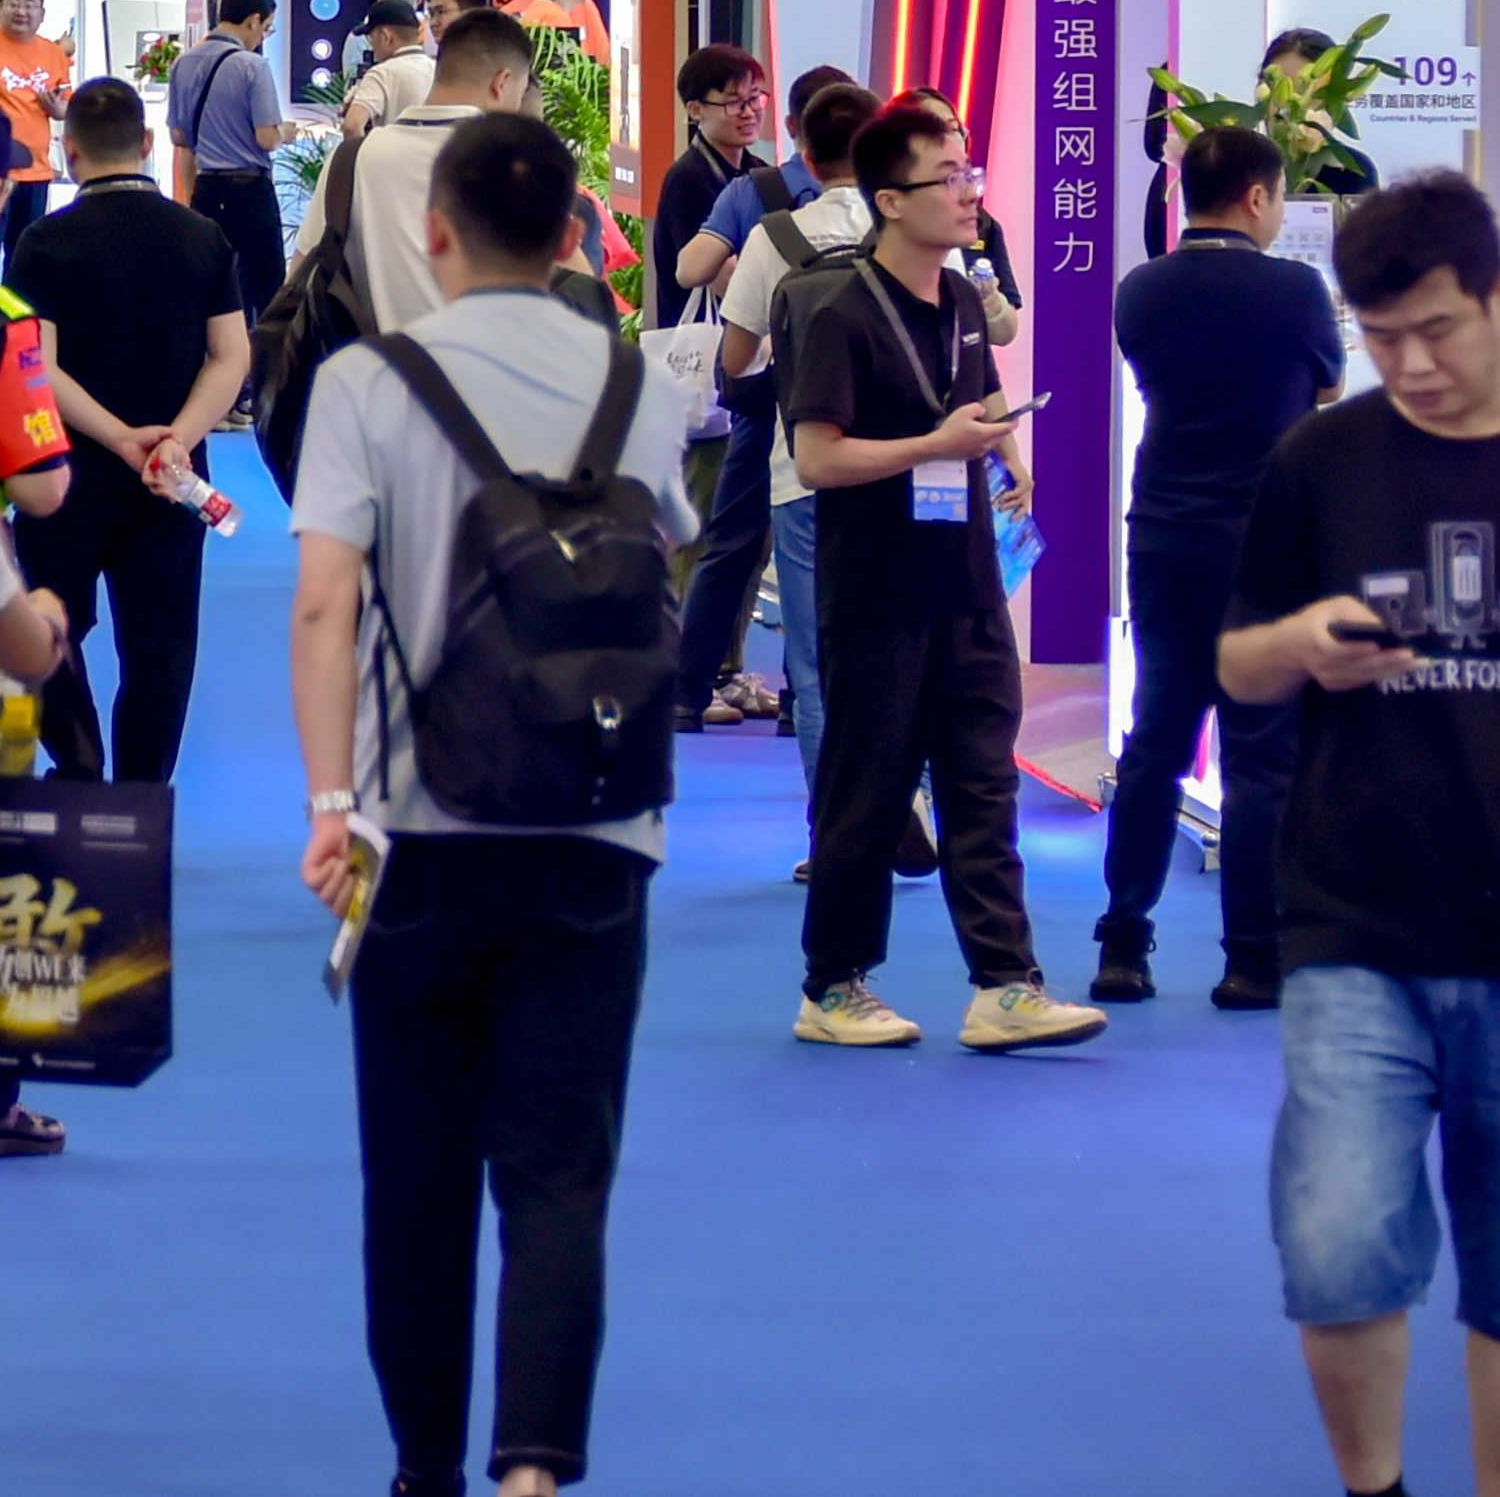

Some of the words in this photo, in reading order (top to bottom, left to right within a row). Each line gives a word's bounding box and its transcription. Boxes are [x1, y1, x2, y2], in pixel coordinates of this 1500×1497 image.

[1349, 93, 1477, 110] 务覆盖国家和地区
